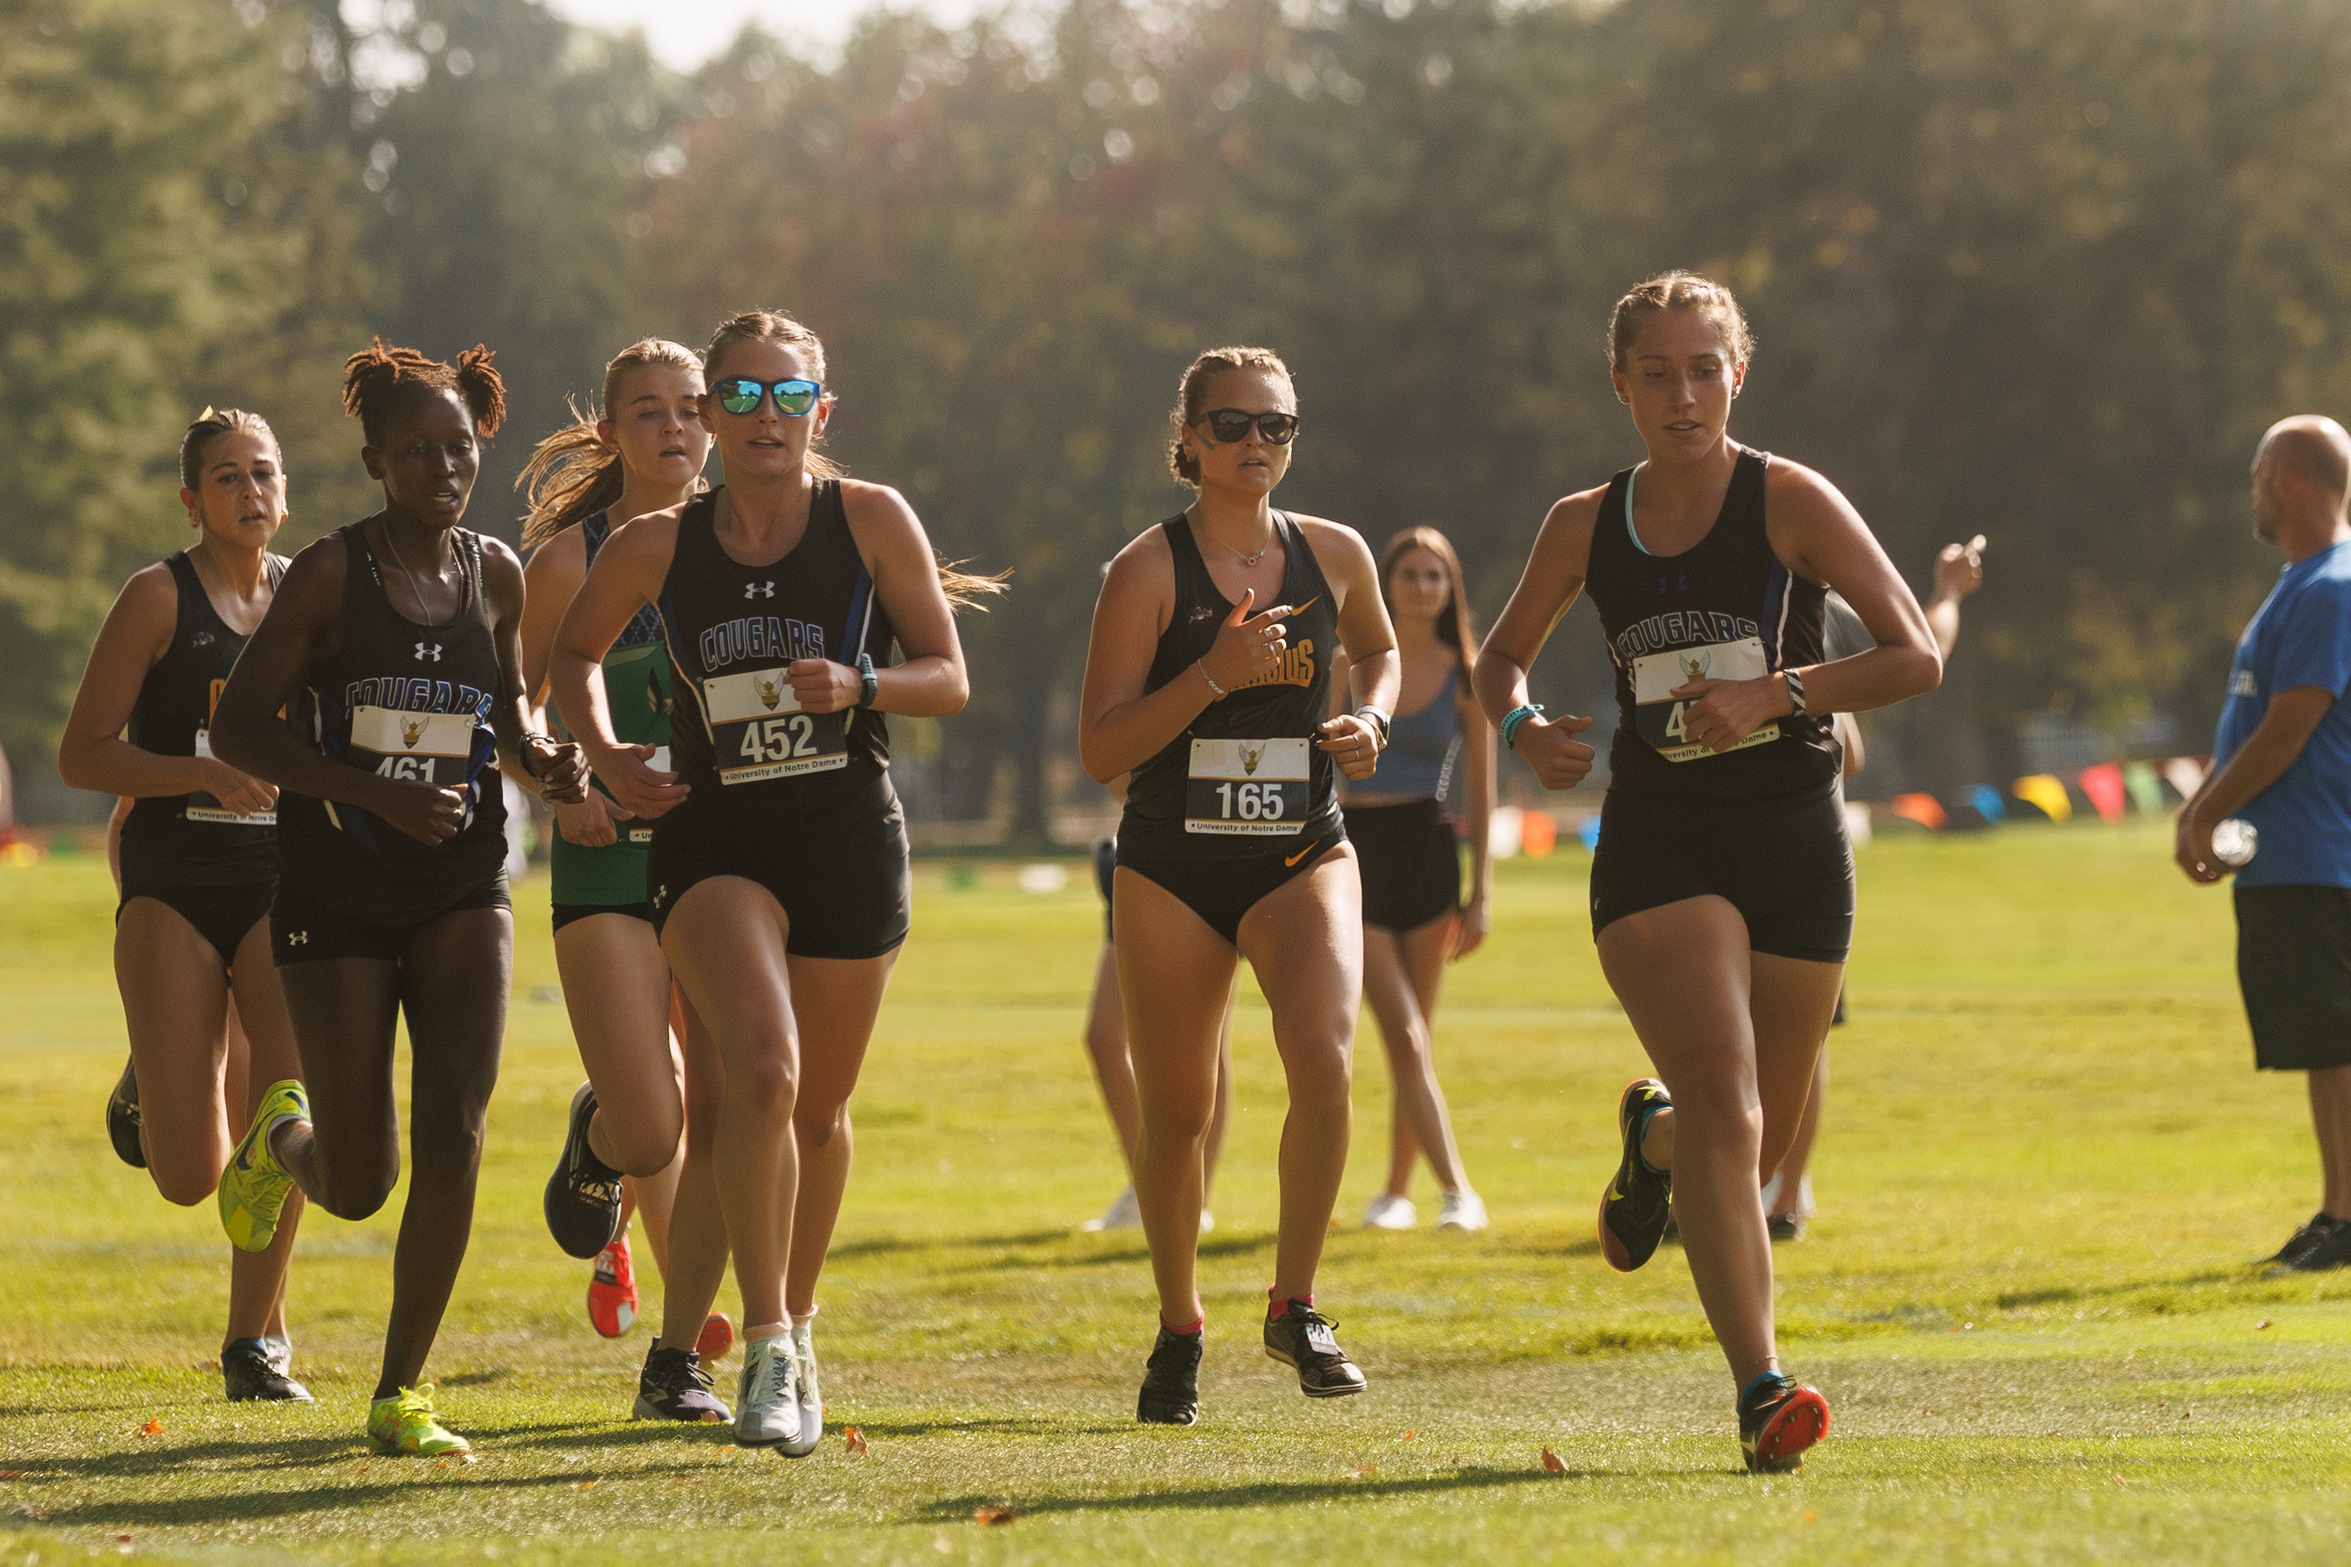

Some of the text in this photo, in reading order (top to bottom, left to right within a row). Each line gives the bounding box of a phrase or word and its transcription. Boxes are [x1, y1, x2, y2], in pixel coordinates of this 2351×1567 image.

[700, 617, 825, 672] COUGARS
[740, 715, 818, 763] 452
[729, 758, 837, 780] University of Notre Dame
[198, 811, 237, 820] University
[1216, 783, 1284, 820] 165
[1197, 823, 1238, 832] University
[1241, 824, 1249, 832] of
[1251, 824, 1274, 832] Notre
